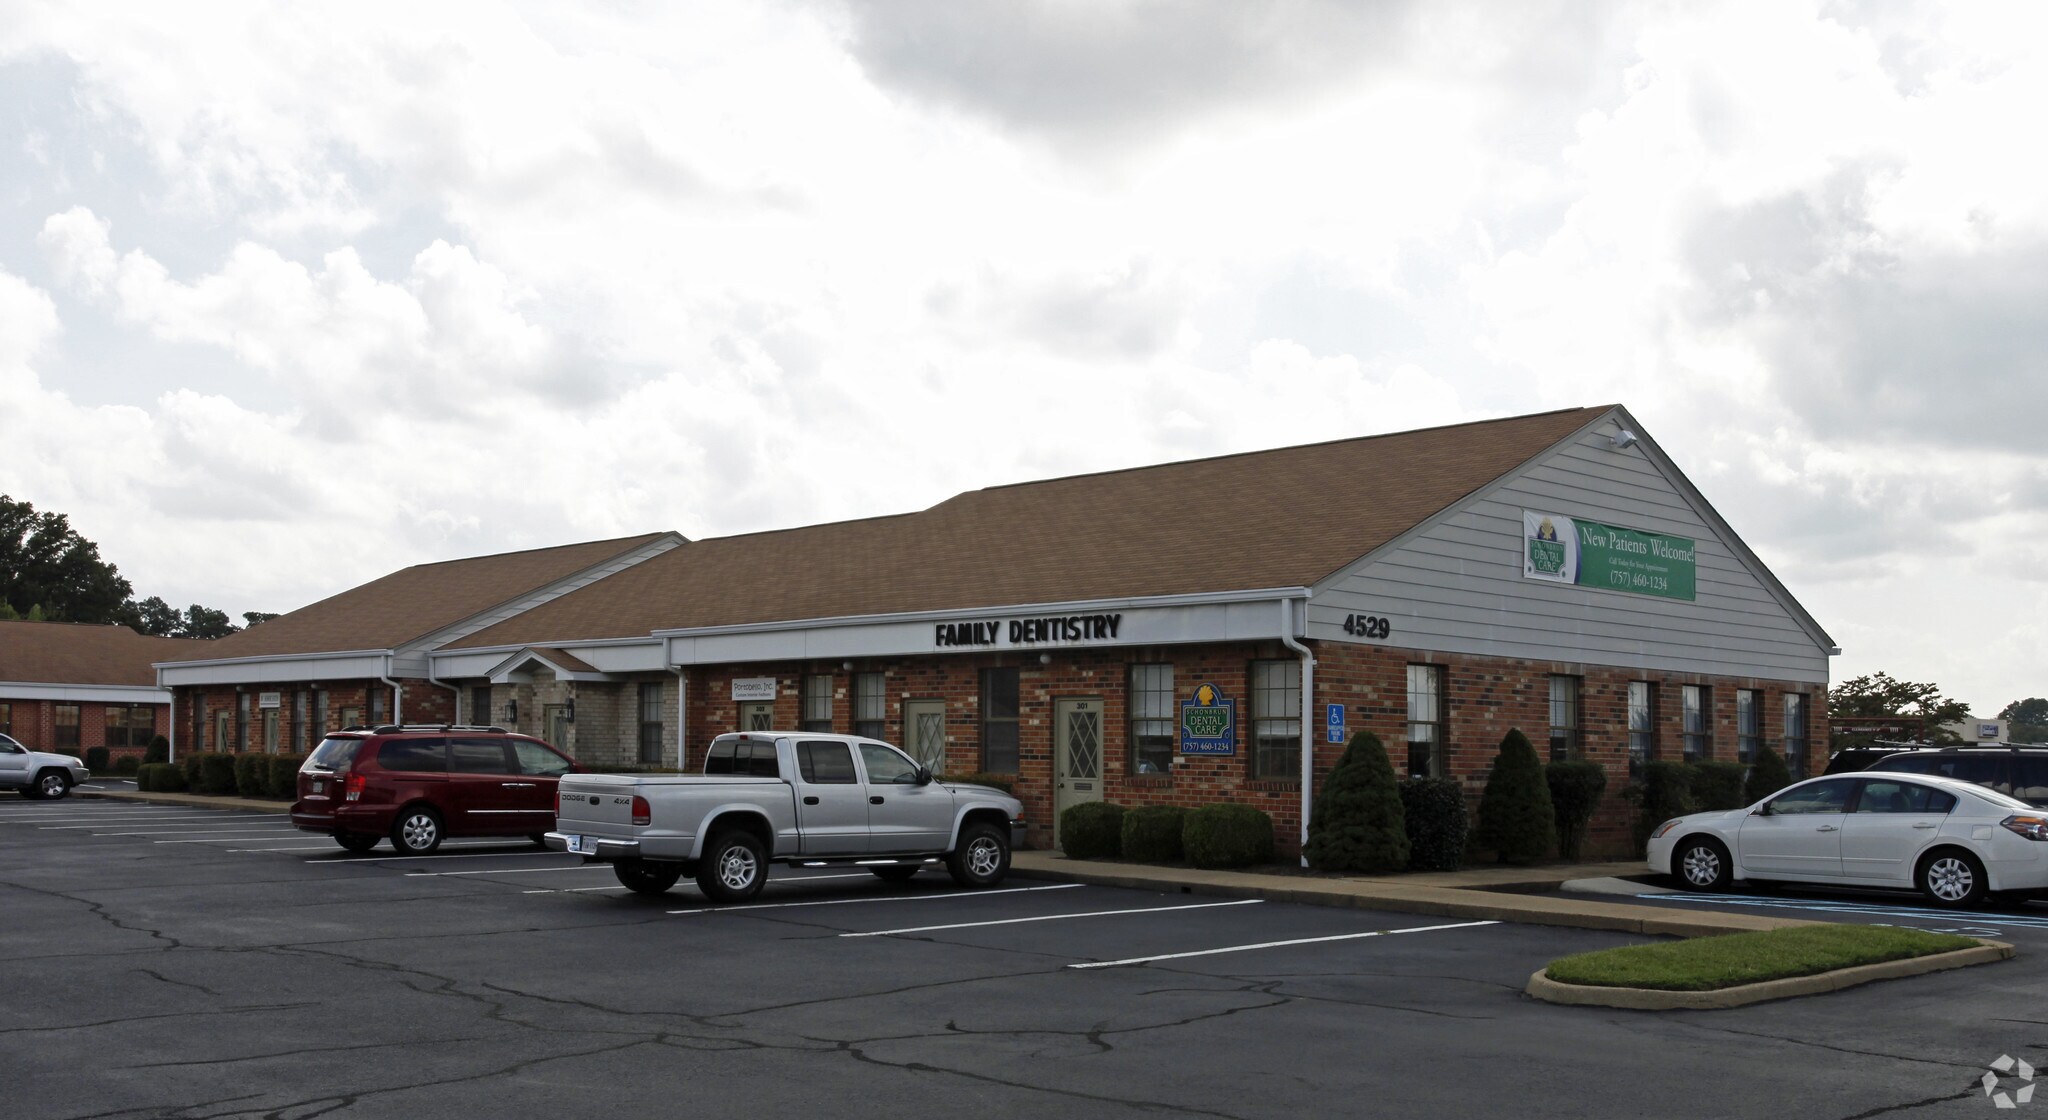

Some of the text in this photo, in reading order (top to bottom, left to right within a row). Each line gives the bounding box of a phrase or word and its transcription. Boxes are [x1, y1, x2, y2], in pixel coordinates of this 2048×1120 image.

[1582, 526, 1694, 562] New Patients Welcome!
[1534, 549, 1560, 563] DENTAL
[1538, 560, 1556, 571] CARE
[1610, 570, 1668, 590] (757) 460-1234
[936, 614, 1121, 646] FAMILY DENTISTRY
[1343, 614, 1390, 639] 4529
[763, 682, 774, 691] Inc.
[1190, 716, 1222, 725] DENTAL
[1195, 726, 1217, 734] CARE
[1183, 742, 1229, 751] (757) 460-1234
